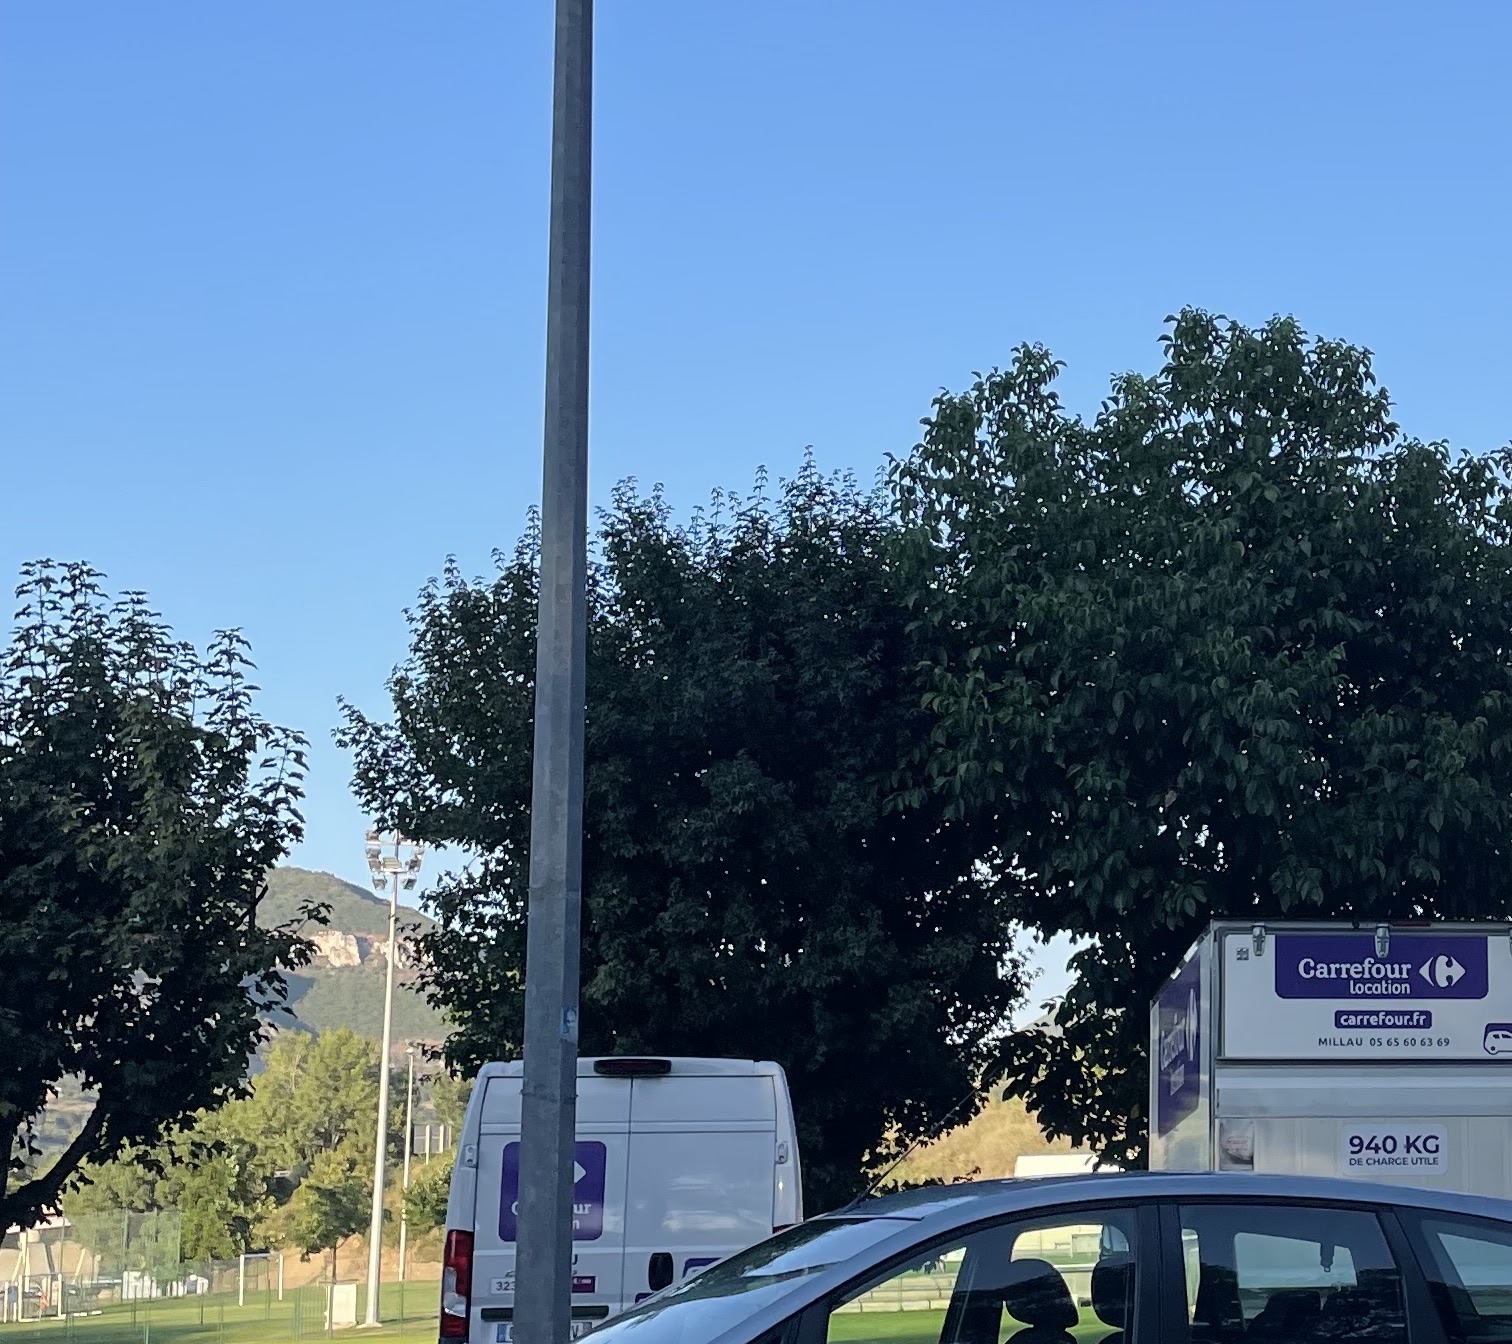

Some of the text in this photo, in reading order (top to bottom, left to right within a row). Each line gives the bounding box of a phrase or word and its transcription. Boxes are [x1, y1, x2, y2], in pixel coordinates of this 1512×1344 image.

[1298, 957, 1412, 979] Carrefour
[1349, 979, 1411, 995] location
[1340, 1011, 1427, 1026] carrefour.fr
[1318, 1037, 1450, 1047] MILLAU 05 65 60 63 69
[1349, 1134, 1440, 1155] 940 KG
[1349, 1157, 1439, 1166] DE CHARGE UTILE
[496, 1281, 516, 1291] 323
